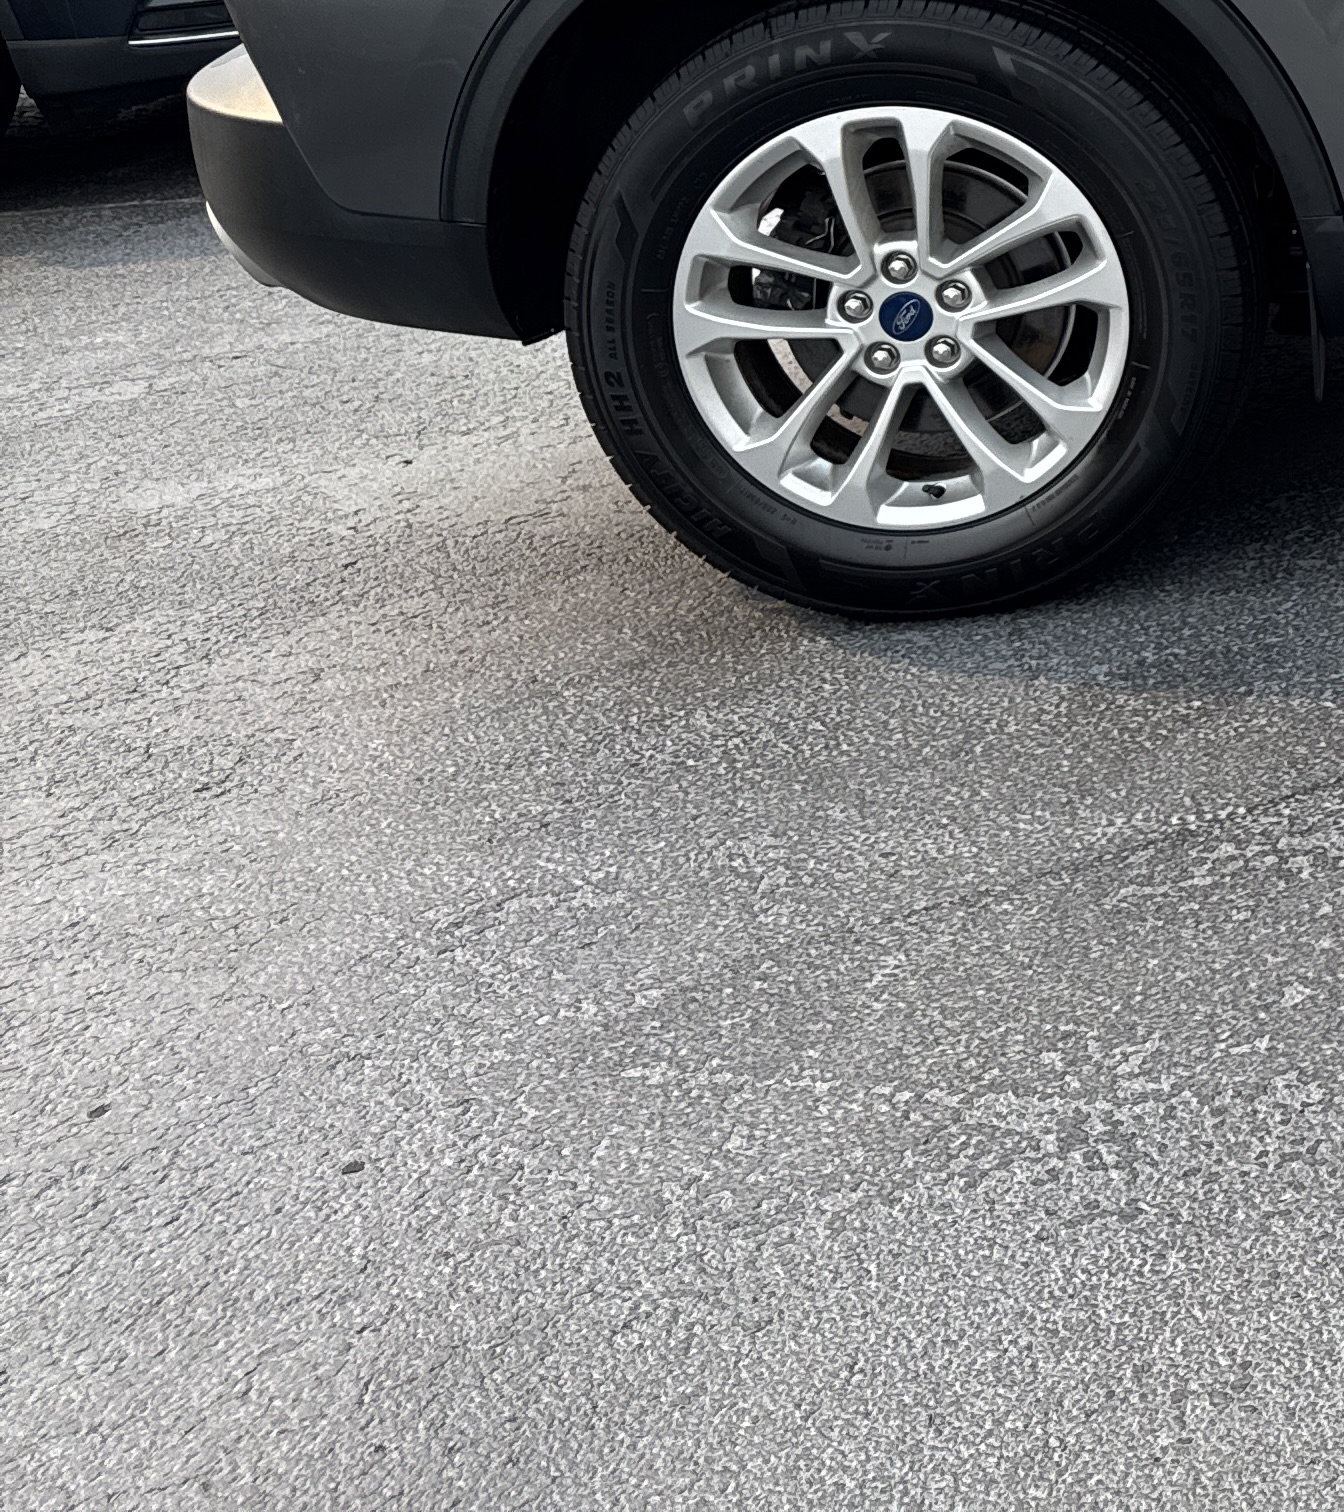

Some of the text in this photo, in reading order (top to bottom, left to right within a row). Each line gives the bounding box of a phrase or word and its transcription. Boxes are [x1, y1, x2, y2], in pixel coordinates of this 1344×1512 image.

[683, 31, 893, 127] PRINX
[896, 304, 917, 330] Ford
[610, 338, 620, 360] ALL
[605, 370, 643, 436] HH2
